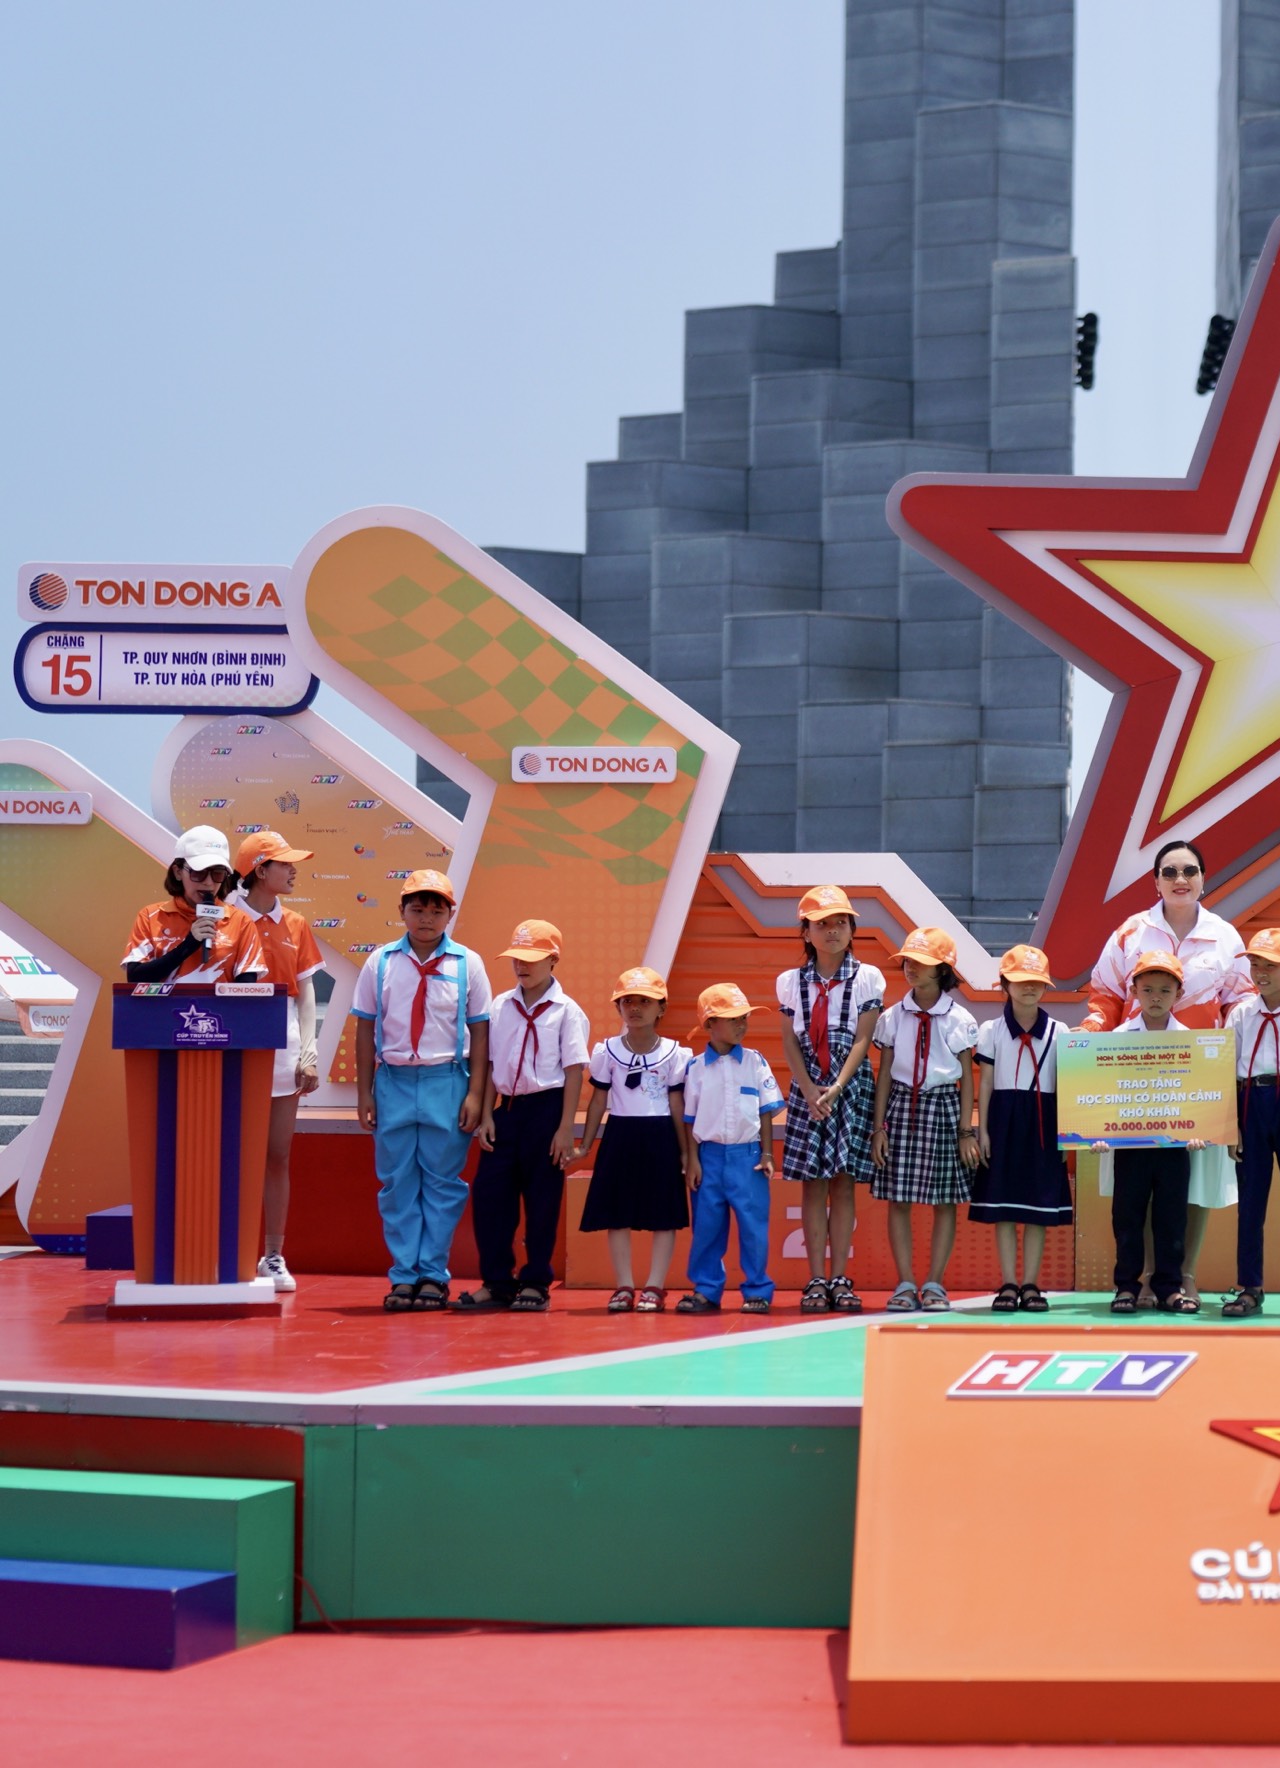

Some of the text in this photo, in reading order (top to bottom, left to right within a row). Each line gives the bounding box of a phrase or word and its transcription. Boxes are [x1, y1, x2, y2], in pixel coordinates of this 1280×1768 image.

[75, 580, 282, 607] TON DONG A
[47, 635, 85, 650] CHẶNG
[122, 650, 286, 669] TP. QUY NHƠN (BÌNH ĐỊNH)
[41, 654, 92, 697] 15
[134, 669, 274, 687] TP. TUY HÒA (PHÚ YÊN)
[546, 757, 667, 773] TON DONG A
[13, 801, 65, 814] DONG
[68, 801, 81, 814] A
[133, 984, 173, 994] HTV
[41, 1015, 59, 1026] TON
[1067, 1040, 1090, 1048] HTV
[1116, 1078, 1181, 1090] TRAO TẶNG
[1077, 1089, 1222, 1107] HỌC SINH CÓ HOÀN CẢNH
[1119, 1106, 1146, 1118] KHÓ
[1104, 1120, 1195, 1132] 20.000.000 VNĐ
[969, 1358, 1176, 1386] HTV
[1197, 1579, 1245, 1601] ĐÀI
